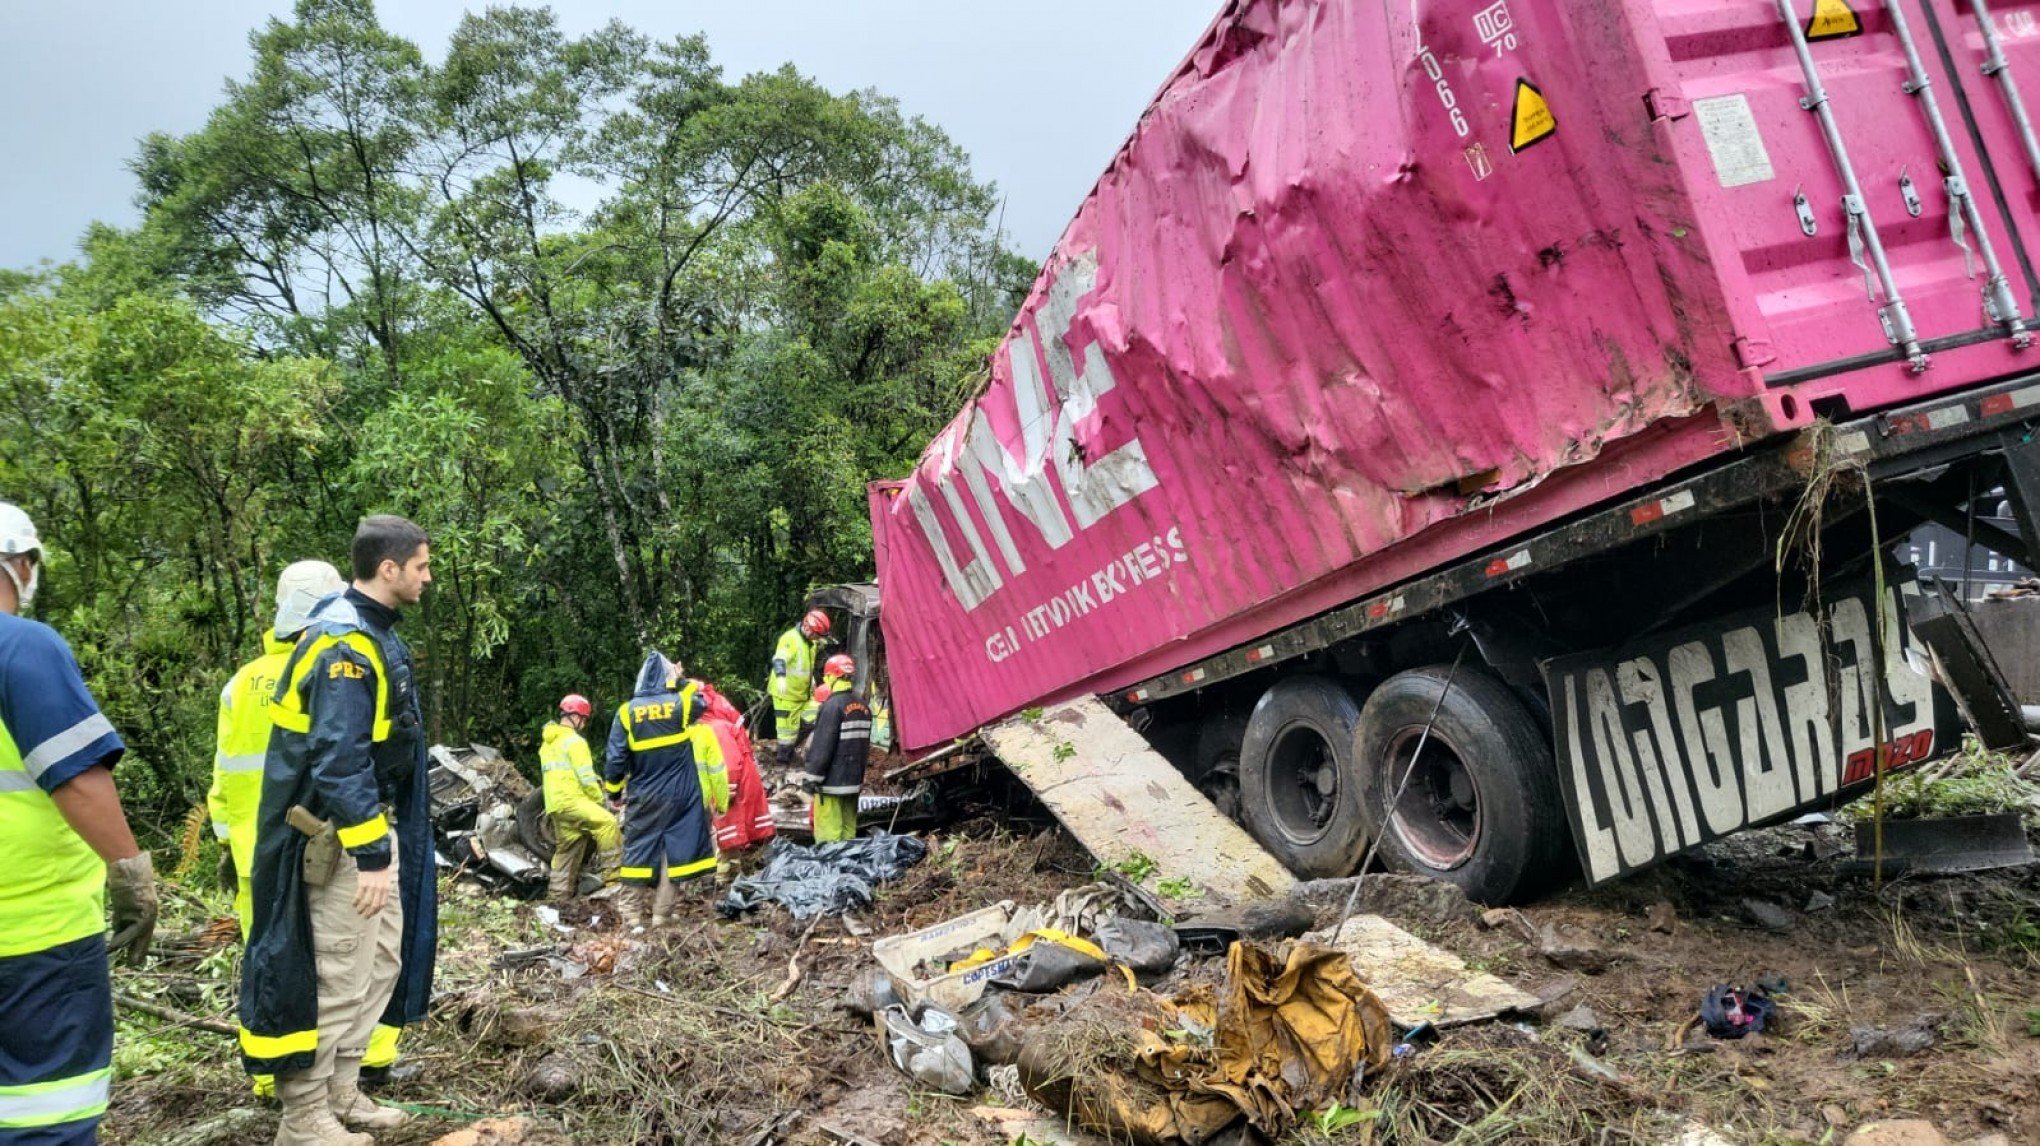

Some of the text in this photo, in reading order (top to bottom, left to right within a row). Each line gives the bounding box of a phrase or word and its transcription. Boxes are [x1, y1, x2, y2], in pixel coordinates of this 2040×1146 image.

[1490, 33, 1518, 58] 70
[328, 660, 366, 681] PRF
[633, 701, 676, 724] PRF
